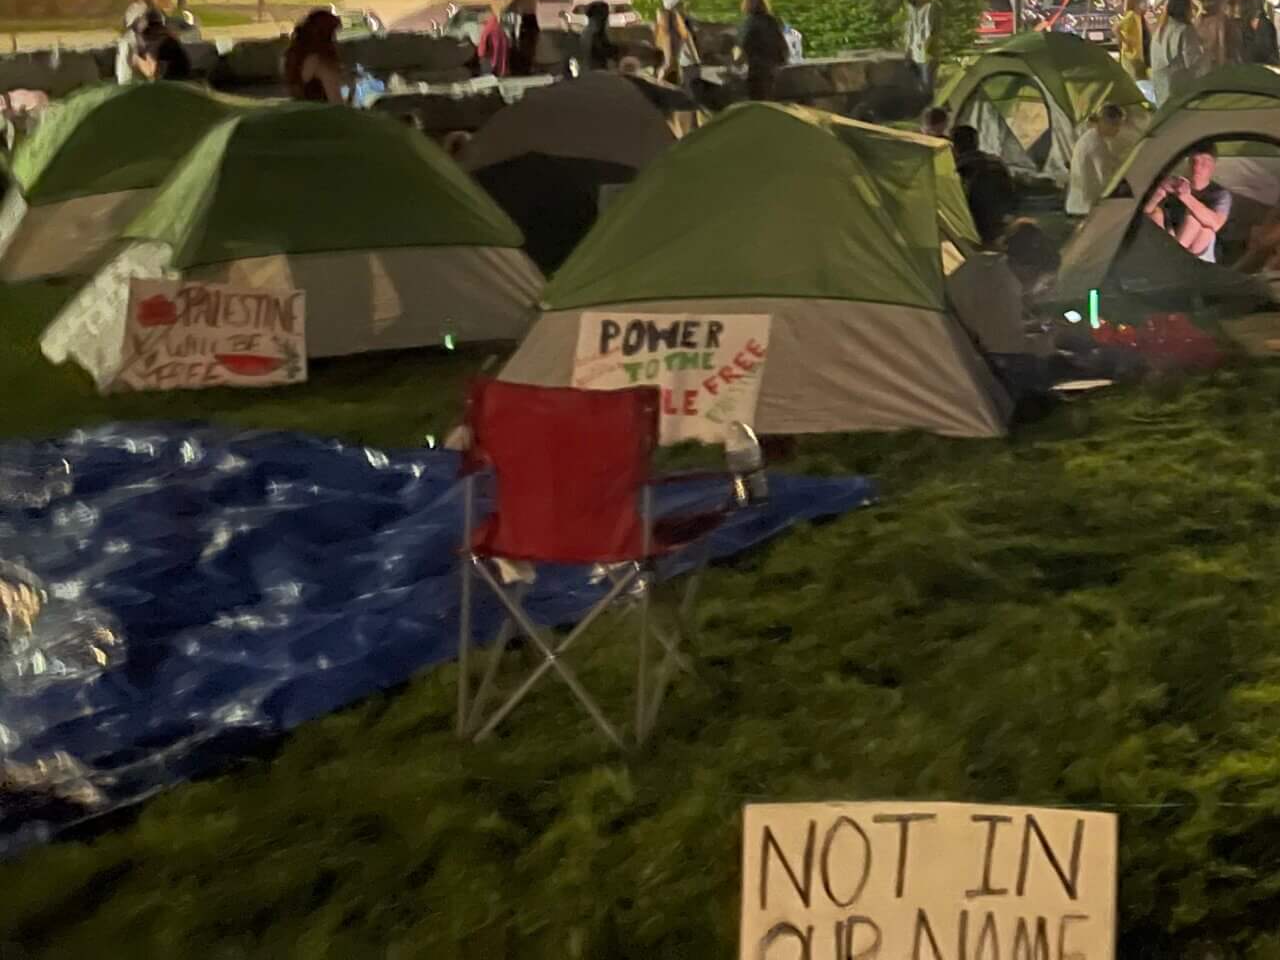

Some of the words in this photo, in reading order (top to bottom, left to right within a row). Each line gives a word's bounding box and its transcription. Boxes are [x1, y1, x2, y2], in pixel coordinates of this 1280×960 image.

[228, 333, 262, 351] BE
[600, 319, 723, 356] POWER
[622, 359, 660, 382] TO
[664, 352, 716, 371] THE
[703, 339, 767, 395] FREE
[759, 813, 937, 910] NOT
[965, 813, 1085, 900] IN
[913, 907, 1090, 960] NAME
